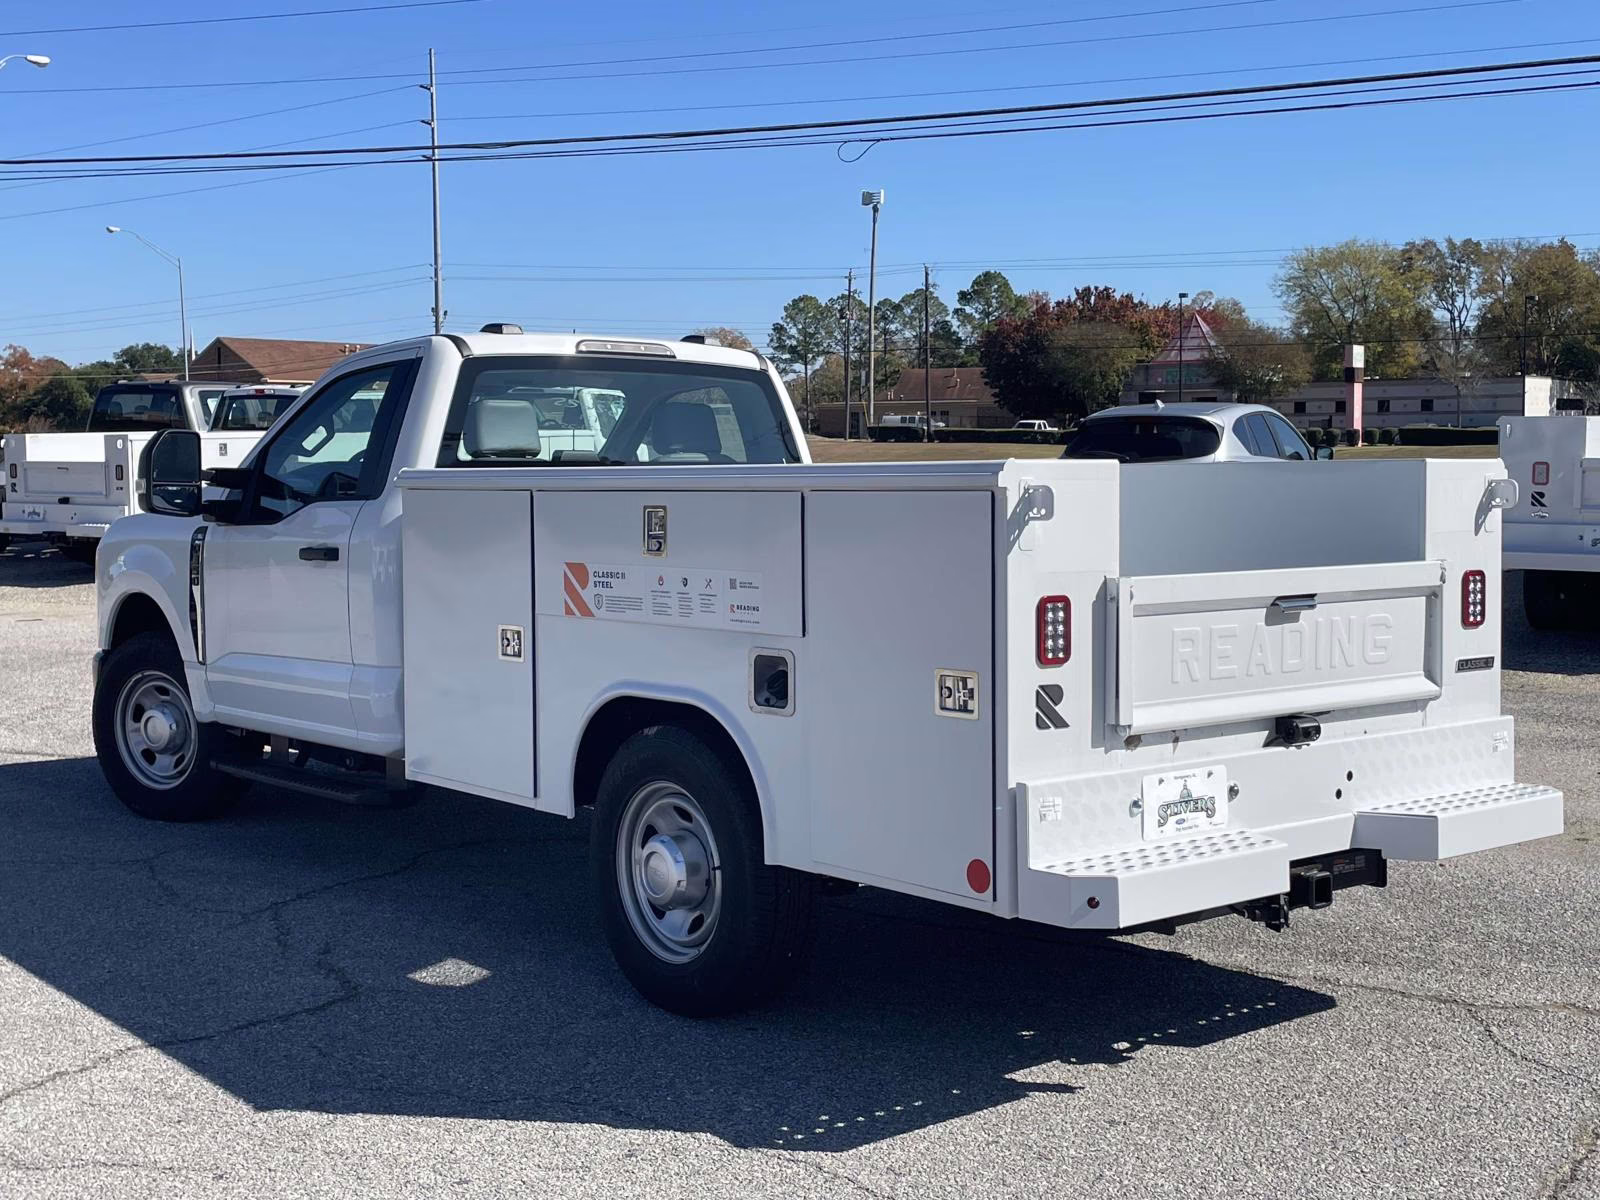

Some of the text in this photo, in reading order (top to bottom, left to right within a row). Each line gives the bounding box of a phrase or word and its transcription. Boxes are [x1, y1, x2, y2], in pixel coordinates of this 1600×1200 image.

[593, 570, 620, 579] CLASSIC
[593, 581, 613, 589] STEEL
[1171, 612, 1394, 685] READING
[1459, 658, 1487, 669] CLASSIC
[1158, 796, 1216, 828] STIVERS
